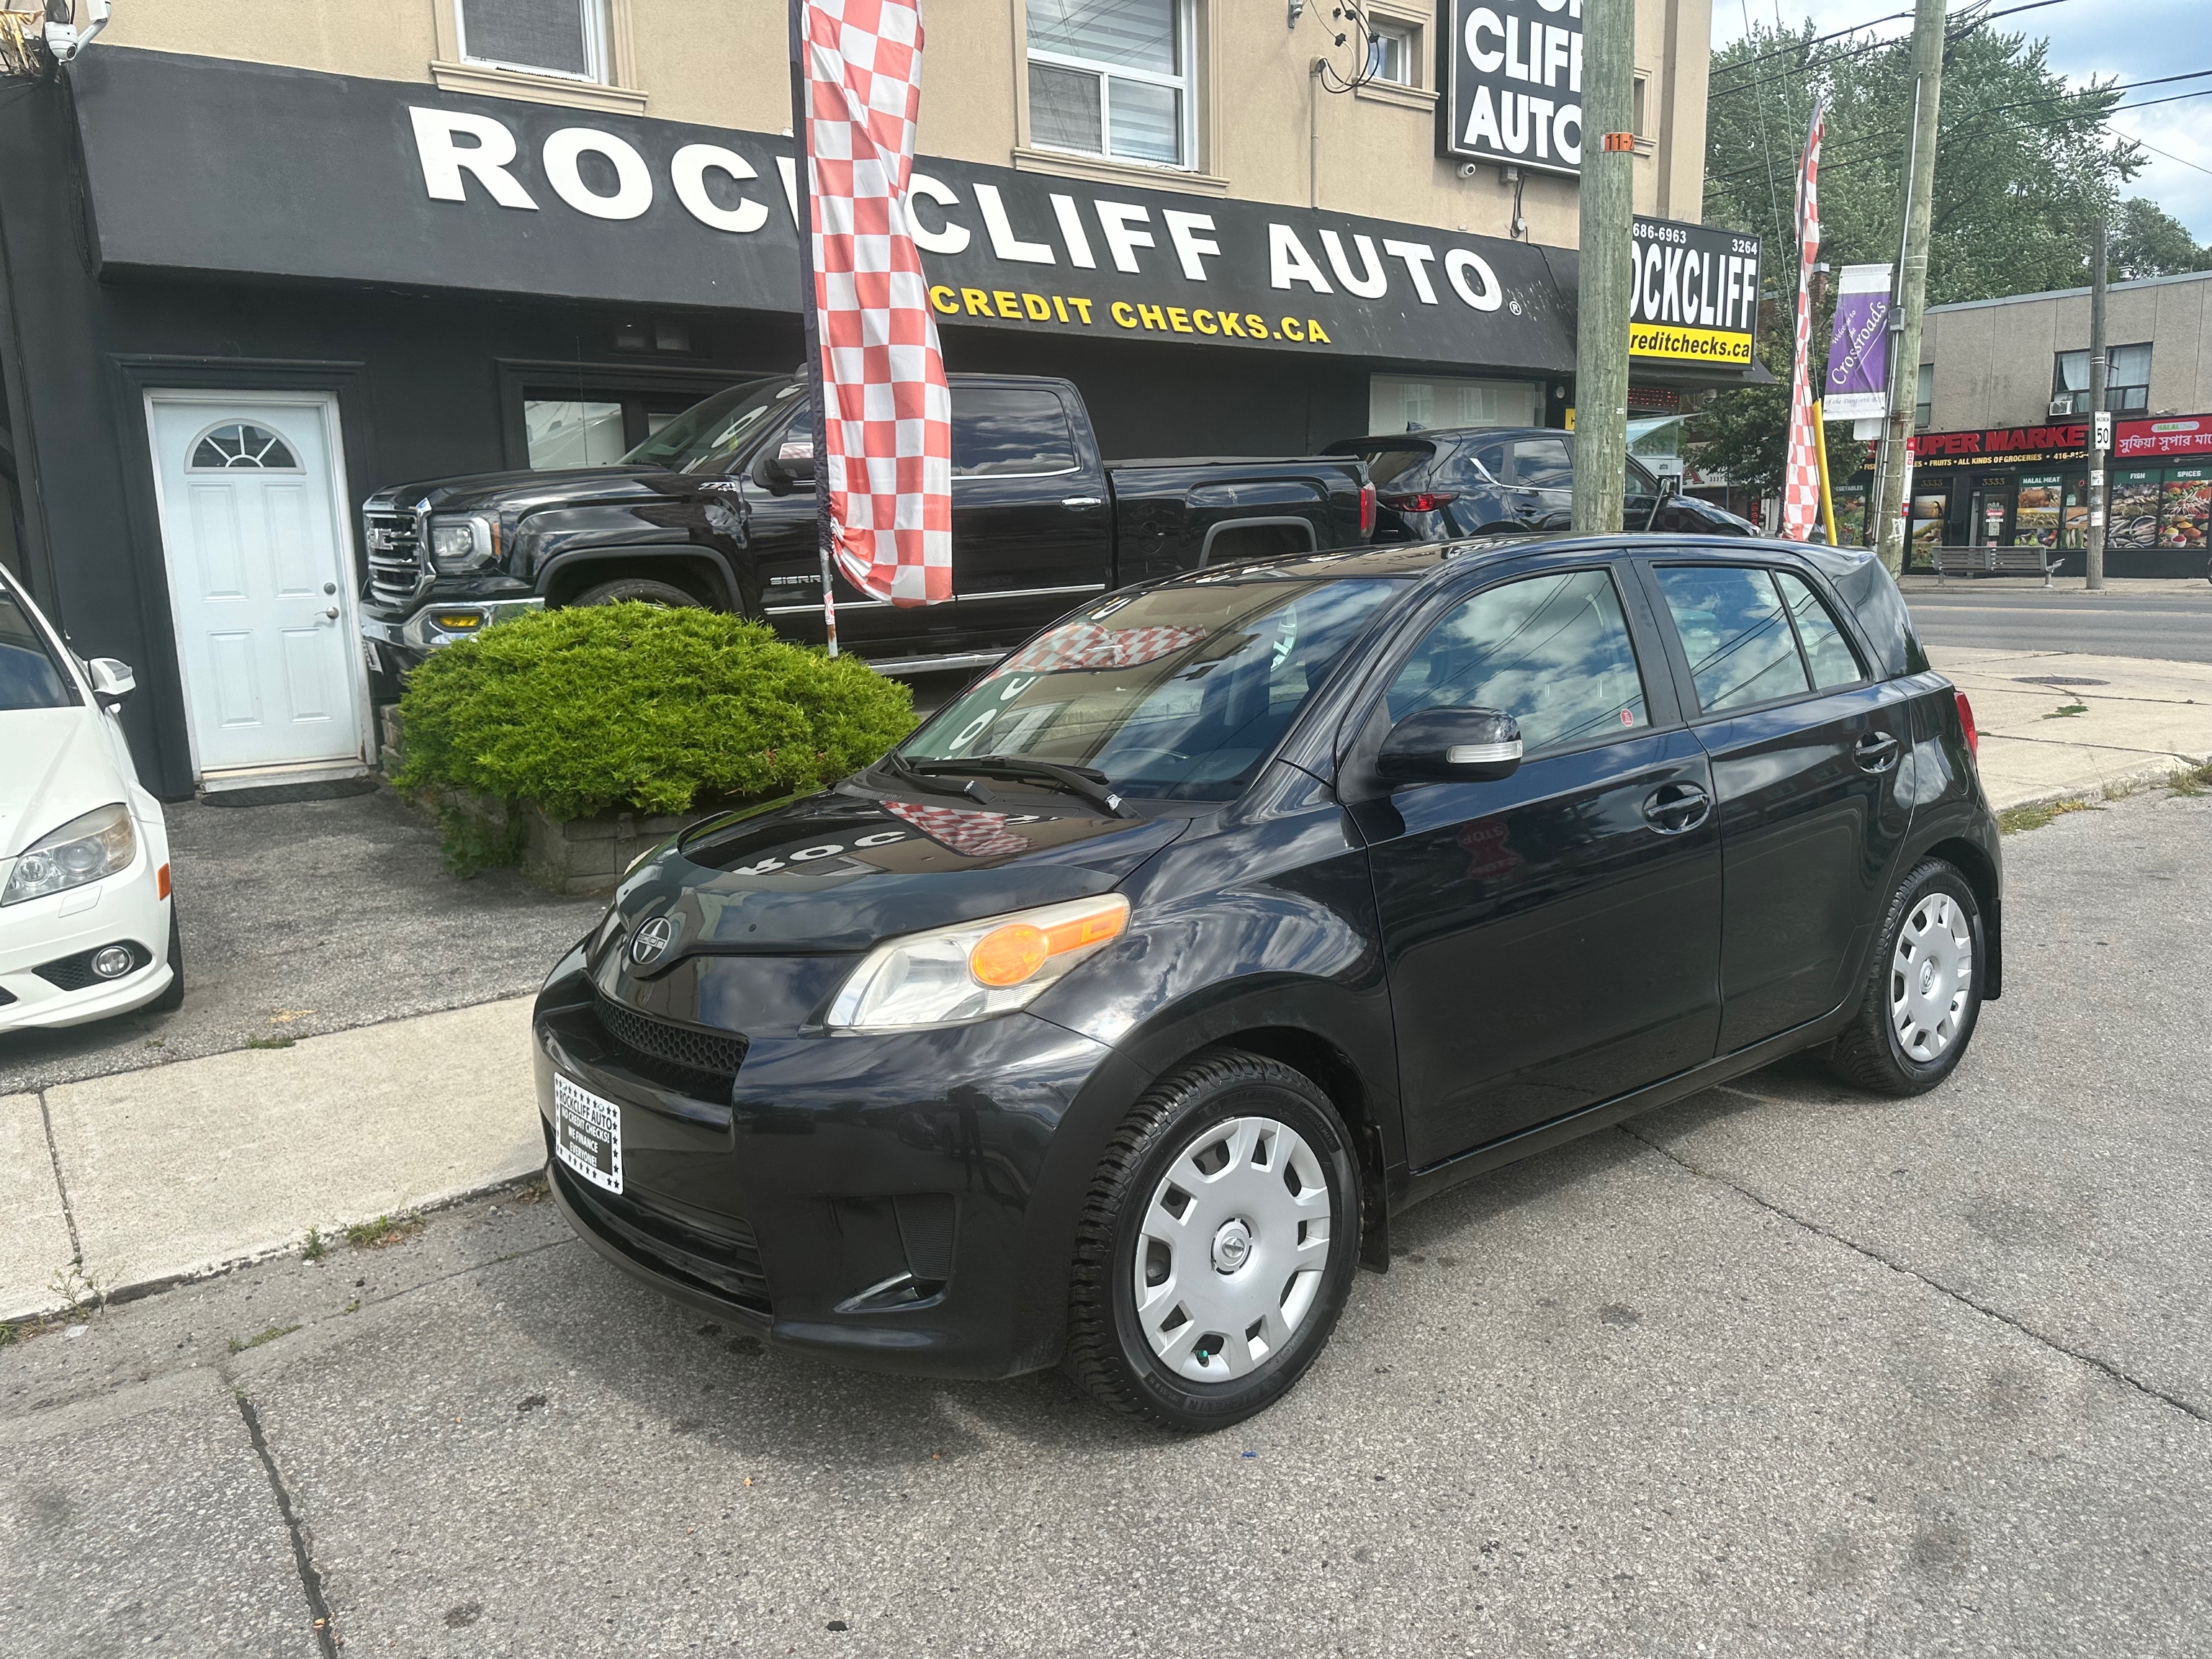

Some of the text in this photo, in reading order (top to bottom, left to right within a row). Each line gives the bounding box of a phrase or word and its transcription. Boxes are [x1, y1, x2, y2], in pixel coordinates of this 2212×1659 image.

[1463, 84, 1582, 165] AUTO
[408, 105, 1502, 313] ROCCLIFF AUTO
[1632, 222, 1757, 255] 686-6963 3264
[930, 285, 1332, 344] CREDIT CHECKS.CA
[1849, 310, 1856, 318] to
[1630, 331, 1750, 357] reditchecks.ca
[1831, 301, 1887, 385] Crossroads
[1843, 397, 1870, 405] Danforth
[1913, 433, 1979, 456] UPER
[2097, 428, 2108, 444] 50
[2004, 454, 2042, 463] GROCERIES
[1920, 479, 1943, 487] 3333
[1982, 477, 2005, 486] 3333
[559, 1089, 612, 1130] ROCKCLIFF AUTO
[561, 1107, 611, 1143] NO CREDIT CHECKS!
[568, 1125, 598, 1154] WE FINANCE
[570, 1141, 598, 1168] EVERYONE!
